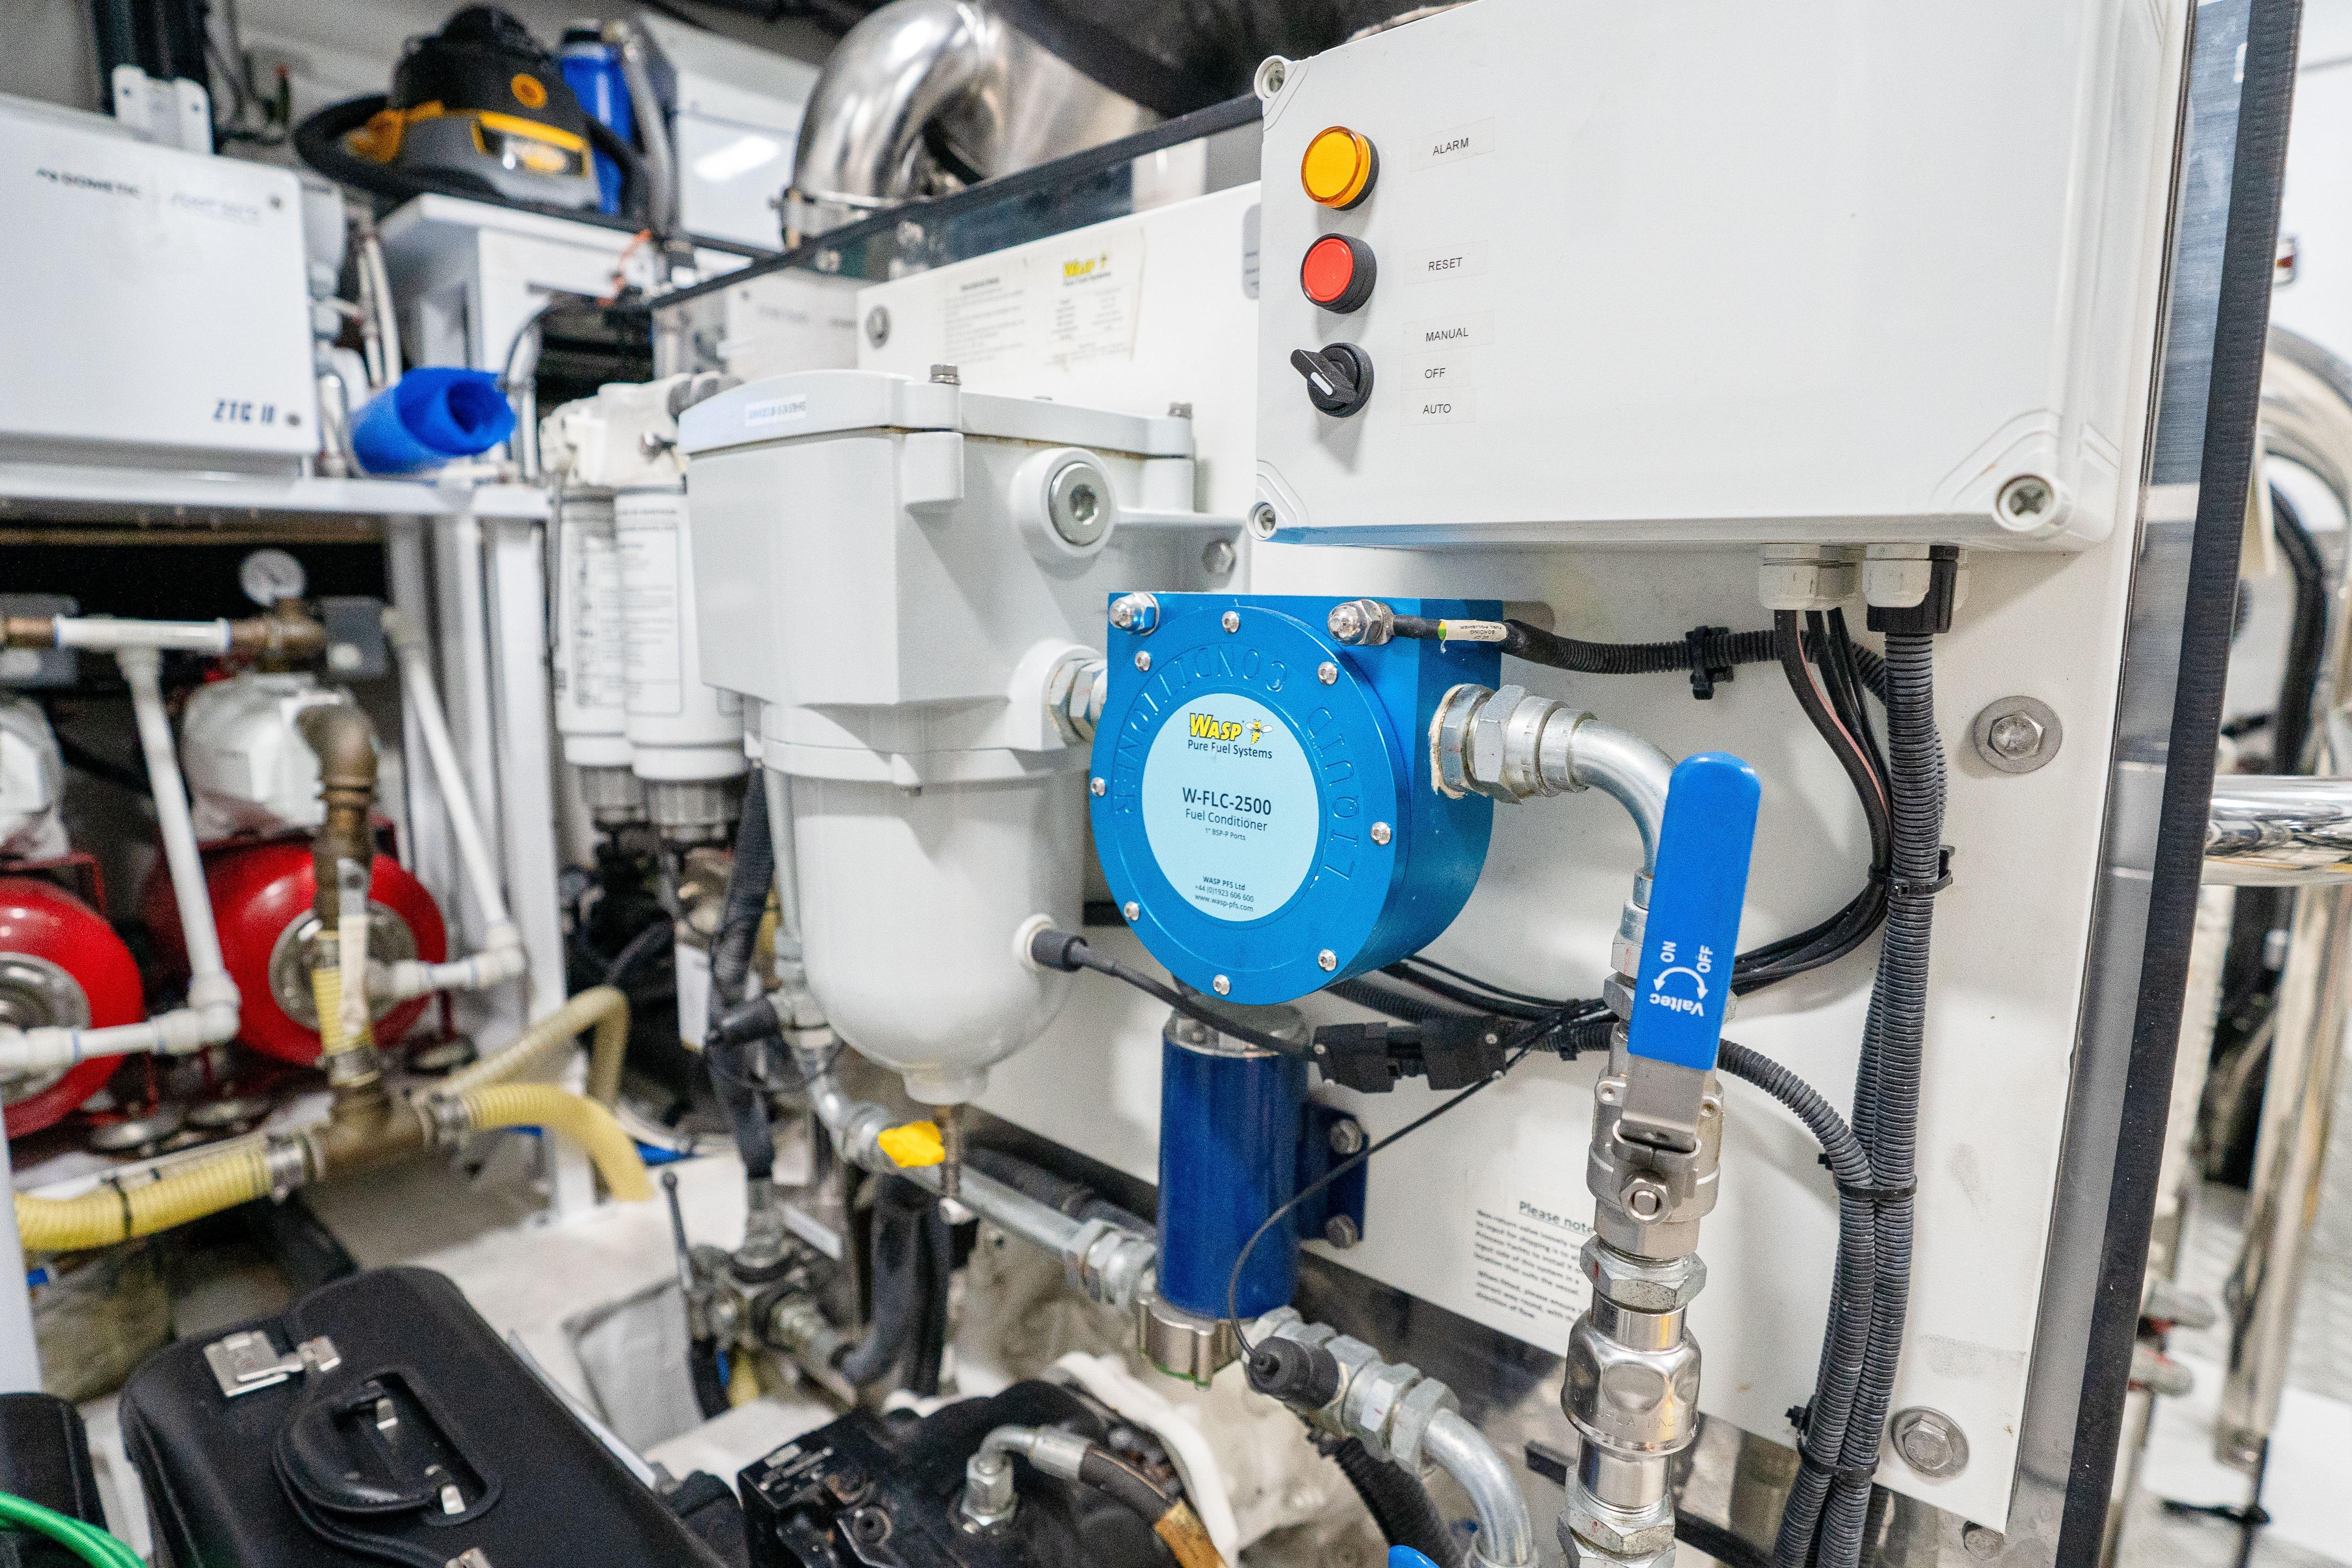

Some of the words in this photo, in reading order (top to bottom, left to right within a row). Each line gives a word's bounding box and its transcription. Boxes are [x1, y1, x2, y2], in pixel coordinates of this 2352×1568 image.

[1432, 137, 1469, 156] ALARM
[1428, 257, 1463, 271] RESET
[1425, 327, 1469, 342] MANUAL
[1424, 368, 1445, 379] OFF
[212, 399, 252, 422] ZTC
[1423, 404, 1451, 414] AUTO
[1188, 739, 1208, 751] Pure
[1211, 742, 1230, 754] Fuel
[1233, 745, 1273, 758] Systems
[1183, 787, 1271, 815] W-FLC-2500
[1186, 808, 1205, 821] Fuel
[1208, 812, 1267, 831] Conditioner
[1230, 832, 1246, 841] Ports
[1203, 876, 1221, 885] WASP
[1222, 880, 1233, 888] PFS
[1206, 886, 1228, 897] (0)1923
[1230, 891, 1241, 900] 606
[1195, 895, 1253, 912] www.wasp-pfs.com
[1660, 940, 1677, 963] ON
[1696, 944, 1713, 973] OFF
[1649, 992, 1704, 1017] Valtec
[1519, 1200, 1561, 1225] Please
